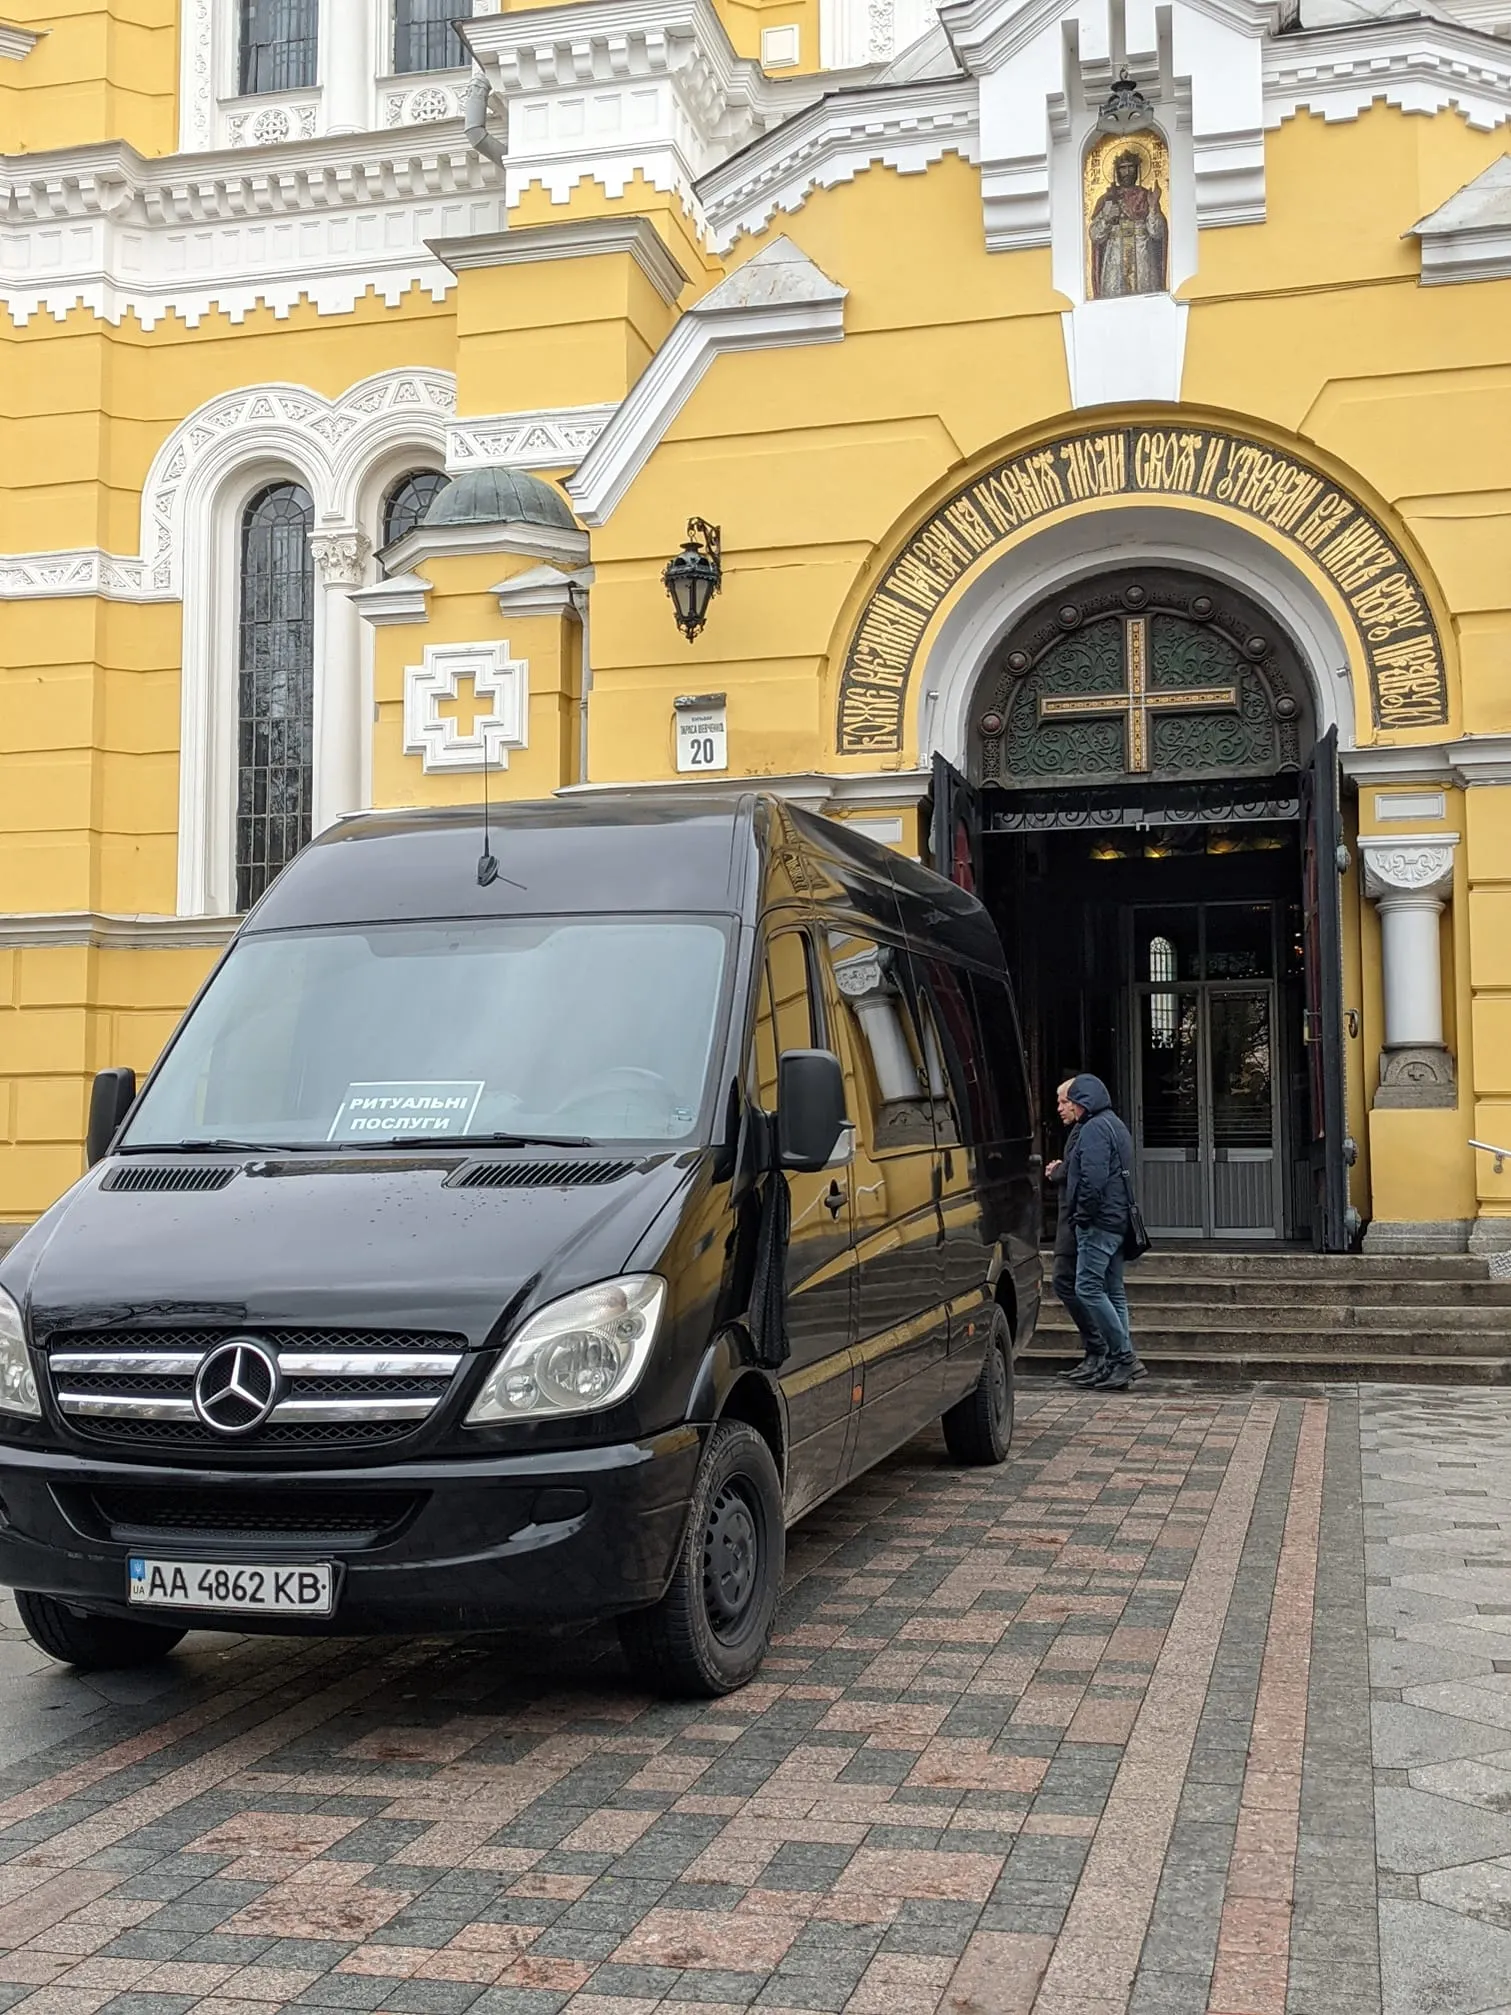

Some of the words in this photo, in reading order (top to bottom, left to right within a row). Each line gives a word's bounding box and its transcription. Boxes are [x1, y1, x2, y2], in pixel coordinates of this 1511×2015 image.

[843, 687, 899, 749] БОЖЕ
[944, 496, 994, 551] НА
[1060, 434, 1126, 499] ЛЮДИ
[1197, 438, 1223, 494] И
[690, 738, 714, 764] 20
[349, 1097, 468, 1110] РИТУАЛЬНІ
[350, 1117, 450, 1130] ПОСЛУГИ
[132, 1585, 145, 1596] UA
[149, 1566, 189, 1599] AA
[198, 1568, 266, 1604] 4862
[274, 1571, 321, 1605] KB
